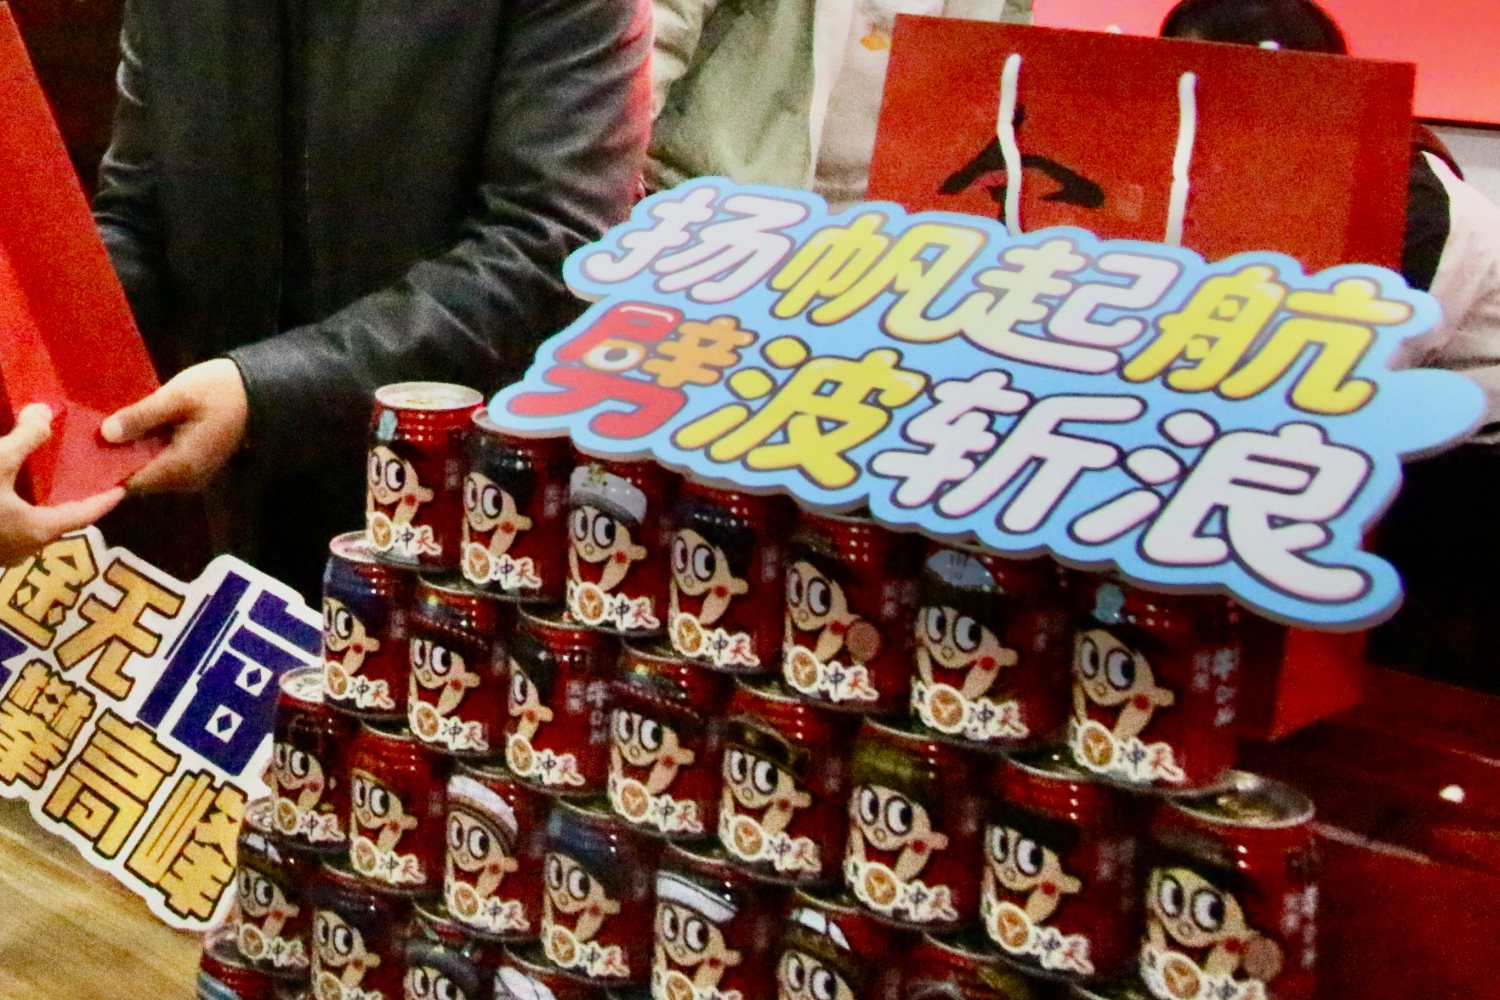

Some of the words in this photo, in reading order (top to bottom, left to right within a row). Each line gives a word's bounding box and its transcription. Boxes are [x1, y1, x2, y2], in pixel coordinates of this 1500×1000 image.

[581, 186, 1414, 415] 扬帆起航
[511, 300, 1375, 604] 劈波斩浪
